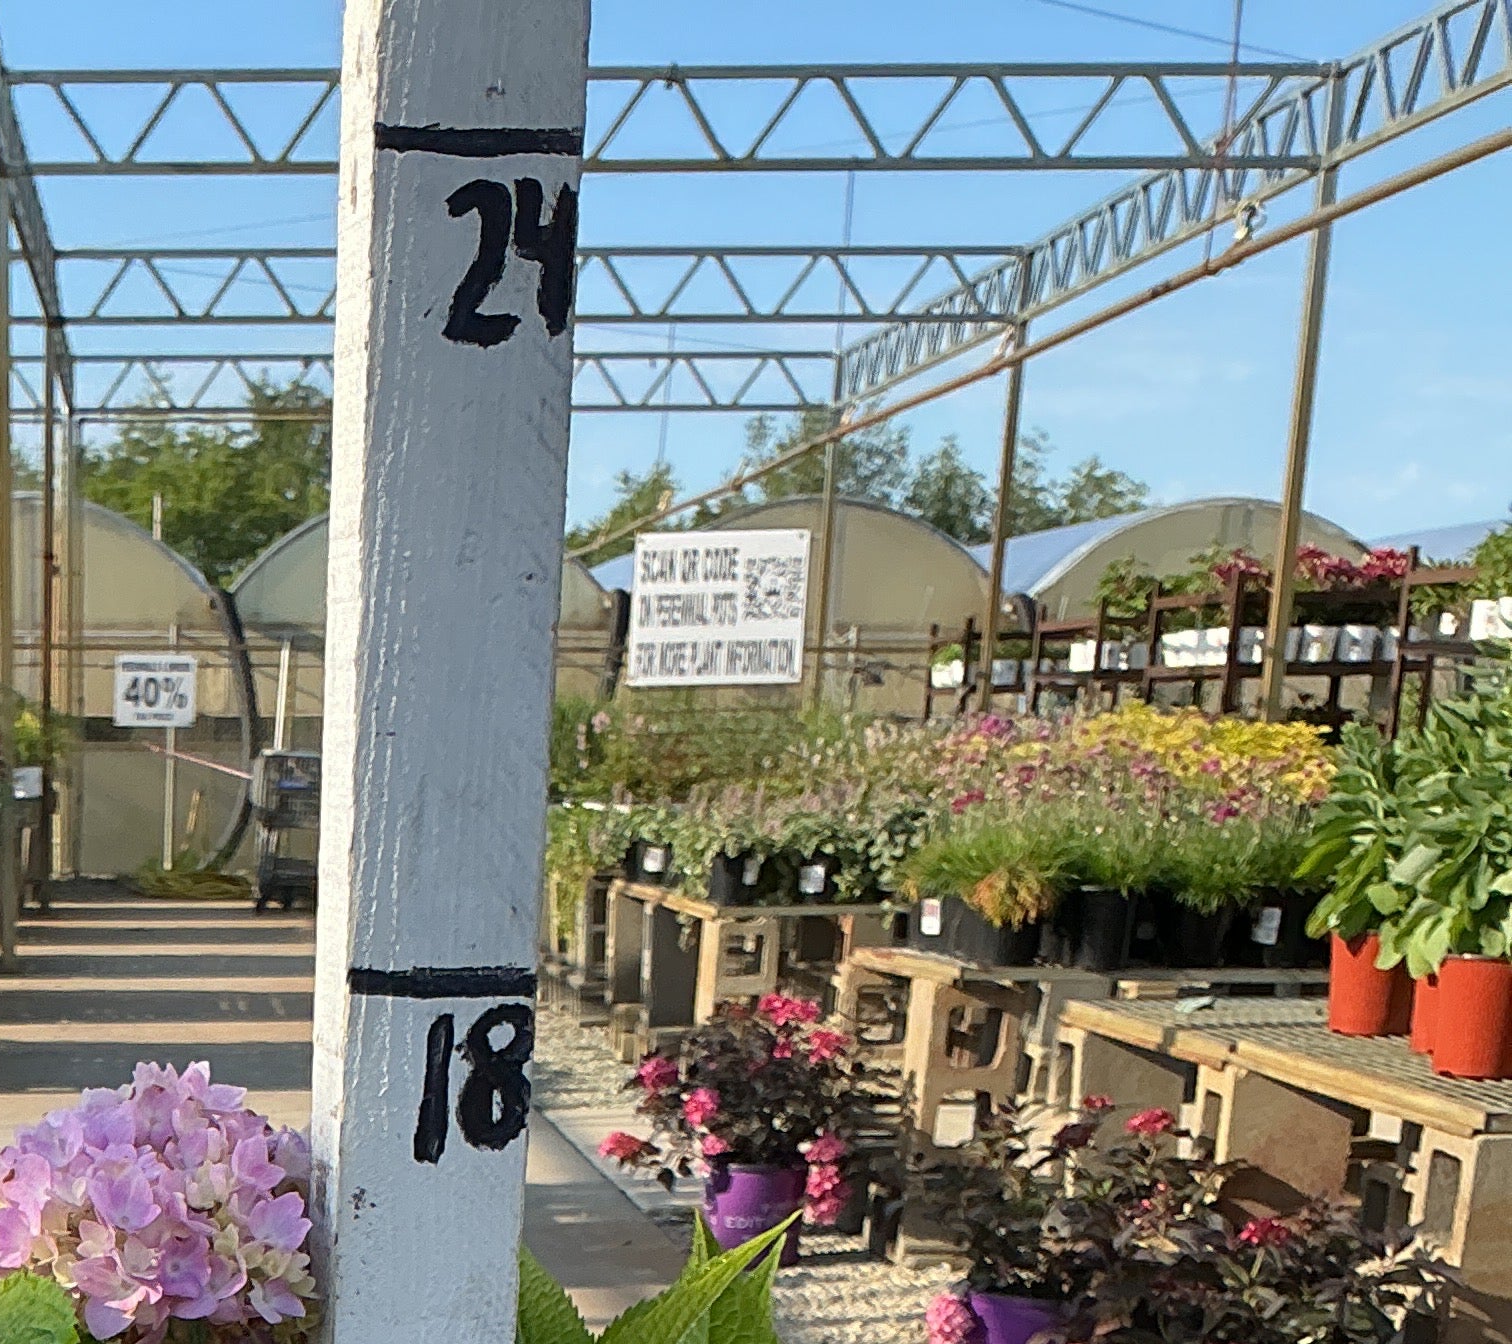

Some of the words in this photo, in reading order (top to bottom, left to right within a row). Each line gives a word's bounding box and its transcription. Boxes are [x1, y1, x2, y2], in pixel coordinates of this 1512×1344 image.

[442, 177, 578, 349] 24
[641, 550, 678, 582] SCAN
[703, 547, 740, 580] CODE
[123, 676, 189, 709] 40%
[413, 1003, 535, 1166] 18
